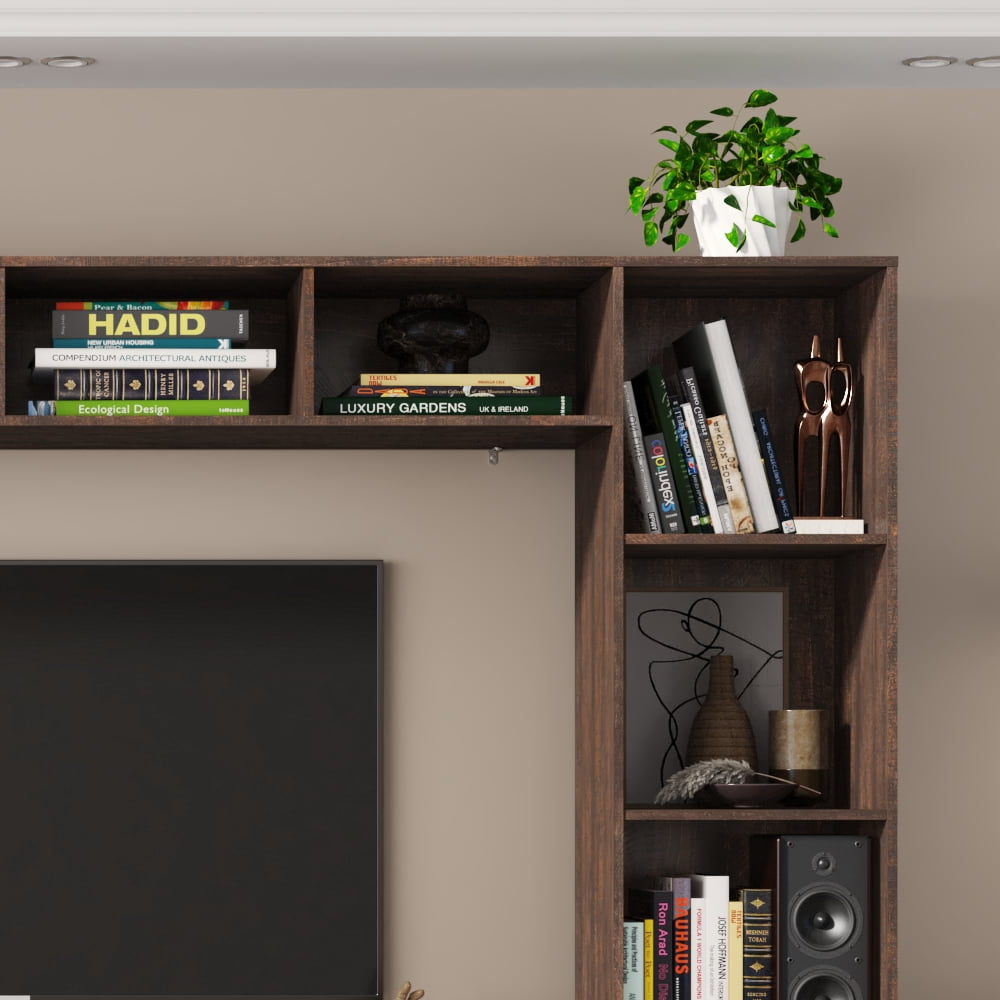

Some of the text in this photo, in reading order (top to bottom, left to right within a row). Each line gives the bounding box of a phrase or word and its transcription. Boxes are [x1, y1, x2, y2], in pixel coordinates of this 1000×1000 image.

[89, 314, 206, 335] HADID
[52, 354, 116, 362] COMPENDIUM
[199, 355, 246, 363] ANTIQUES
[78, 405, 169, 417] Ecological Design
[340, 404, 395, 413] LUXURY
[399, 403, 466, 413] GARDENS
[658, 902, 668, 925] Ron
[658, 928, 668, 956] Arad
[674, 897, 689, 974] BAUHAUS
[717, 916, 726, 979] JOSEF HOFFMANN
